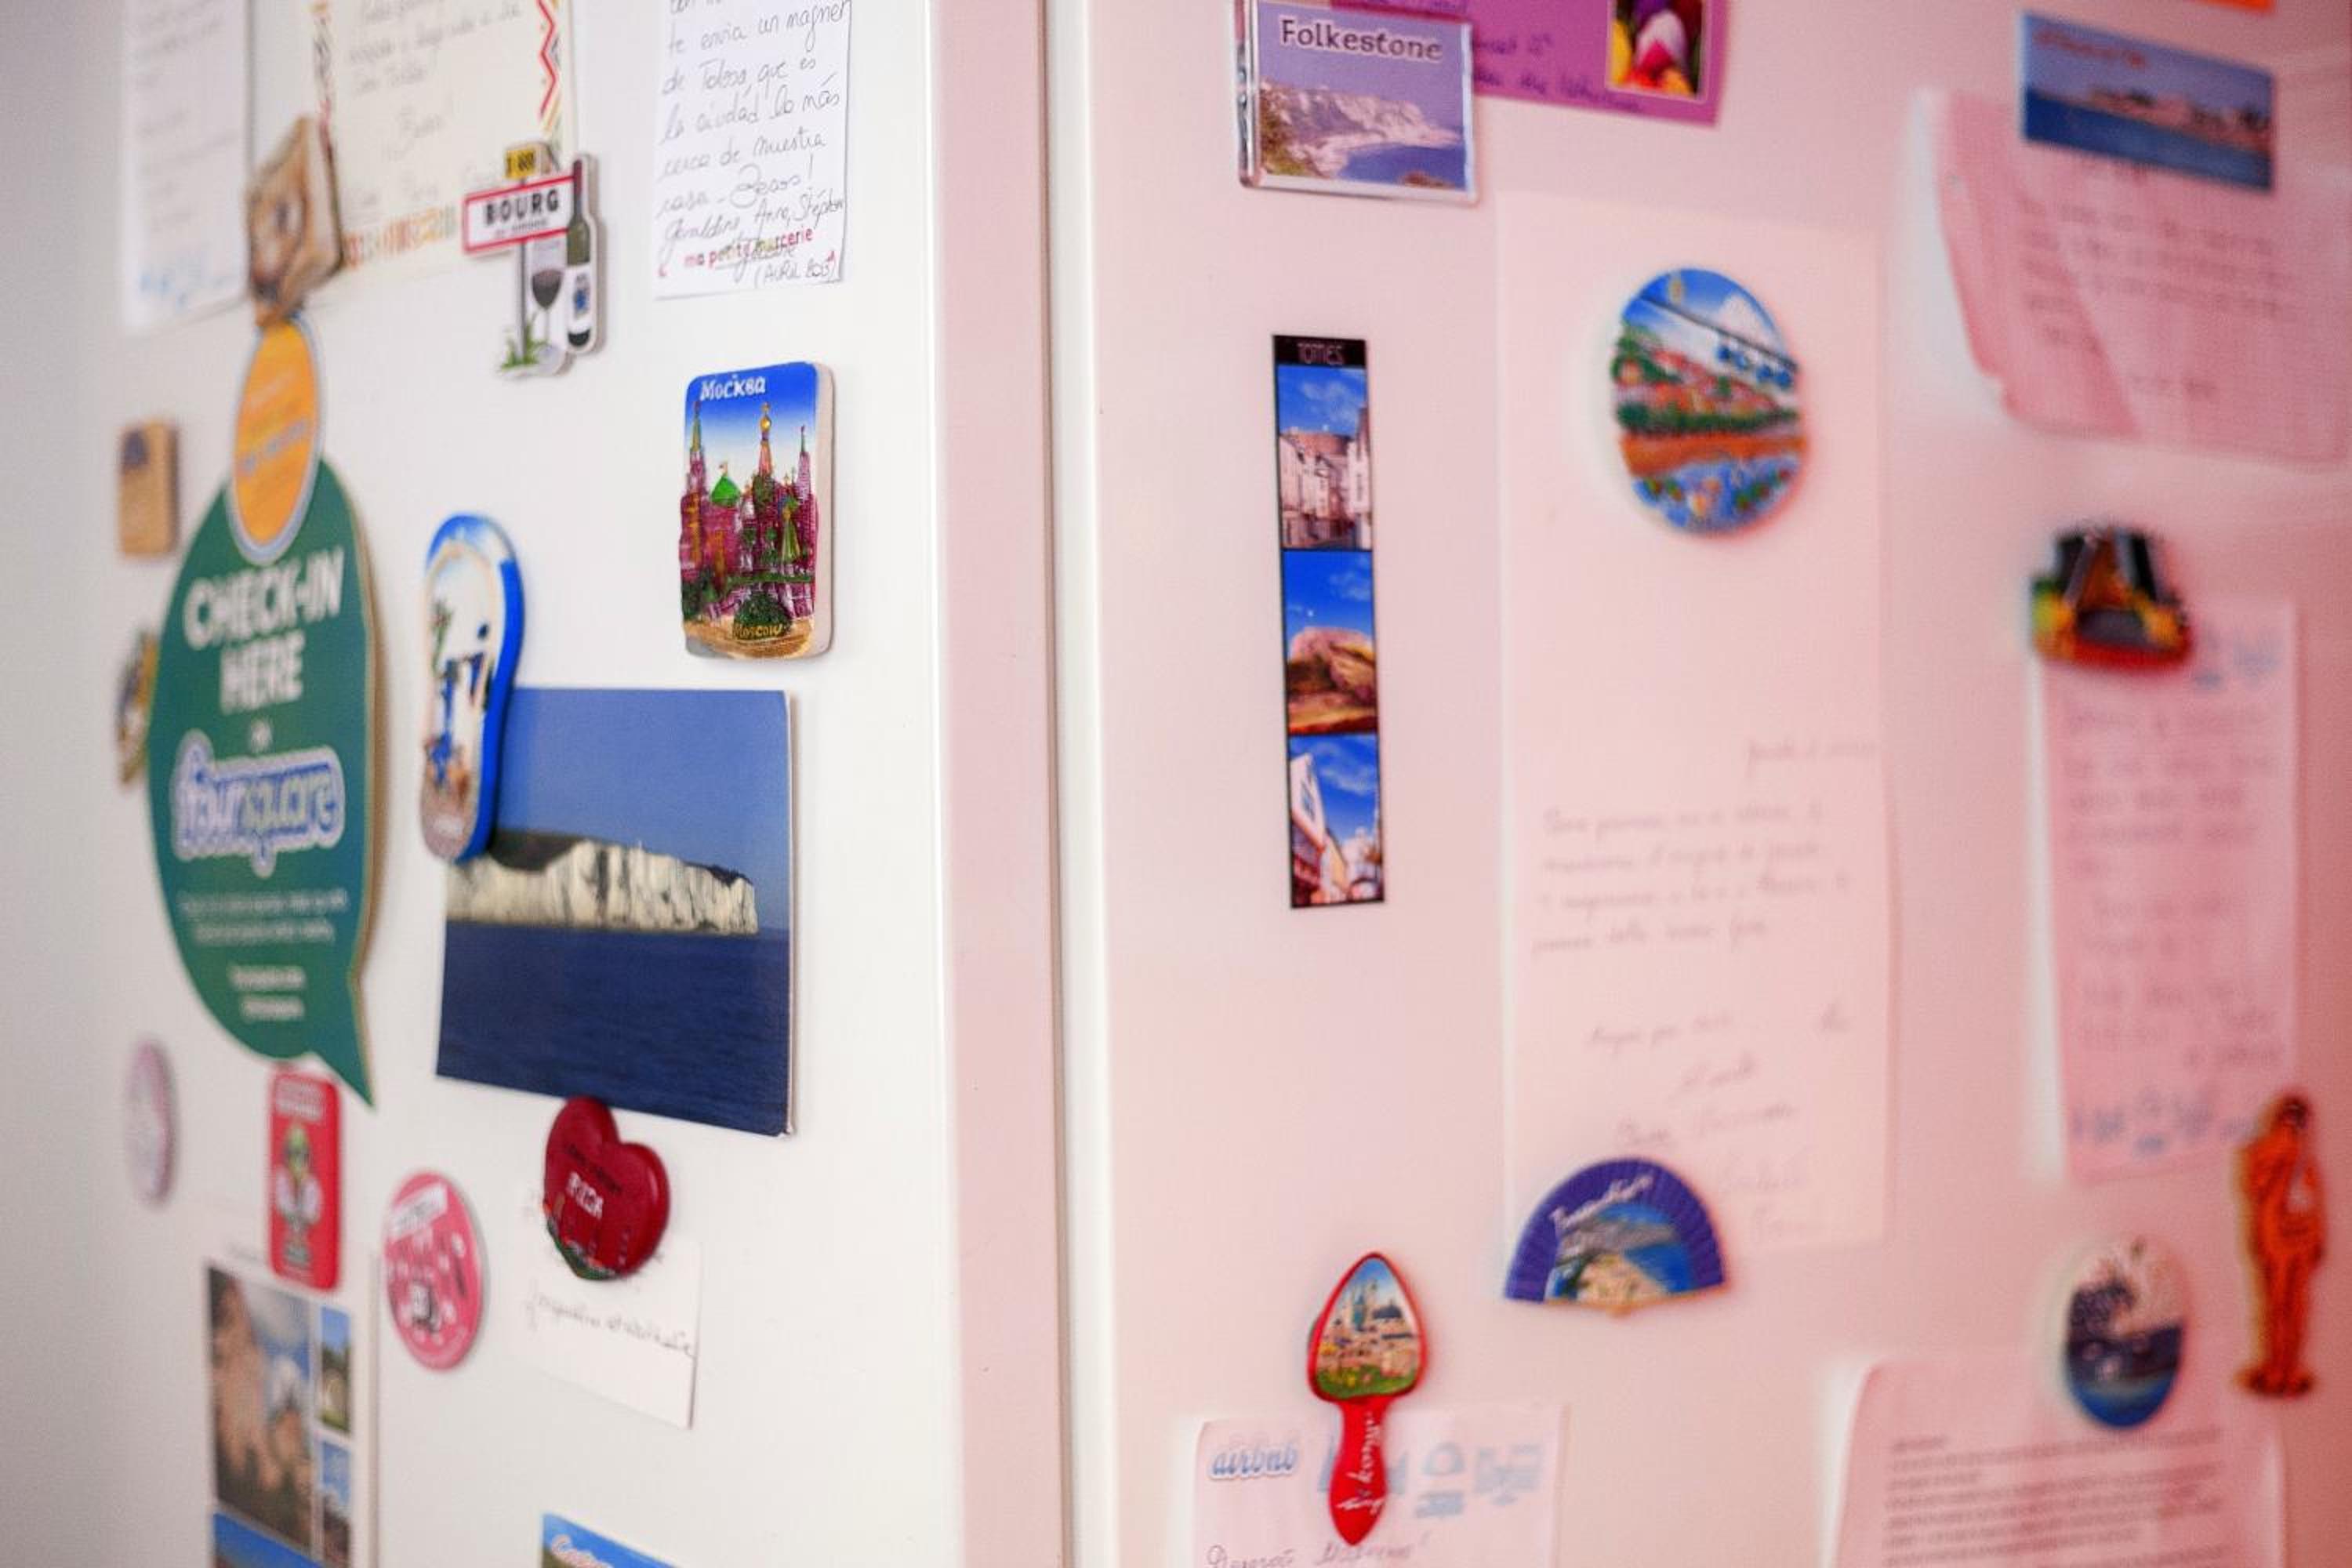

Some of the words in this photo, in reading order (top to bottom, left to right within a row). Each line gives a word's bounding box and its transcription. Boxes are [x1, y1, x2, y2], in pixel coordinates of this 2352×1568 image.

[1281, 17, 1443, 61] Folkestone
[485, 189, 560, 226] BOURG
[684, 252, 706, 267] ma
[700, 376, 767, 401] Москва
[183, 546, 345, 650] CHECK-IN
[220, 630, 307, 714] HERE
[1210, 1444, 1298, 1479] airbnb
